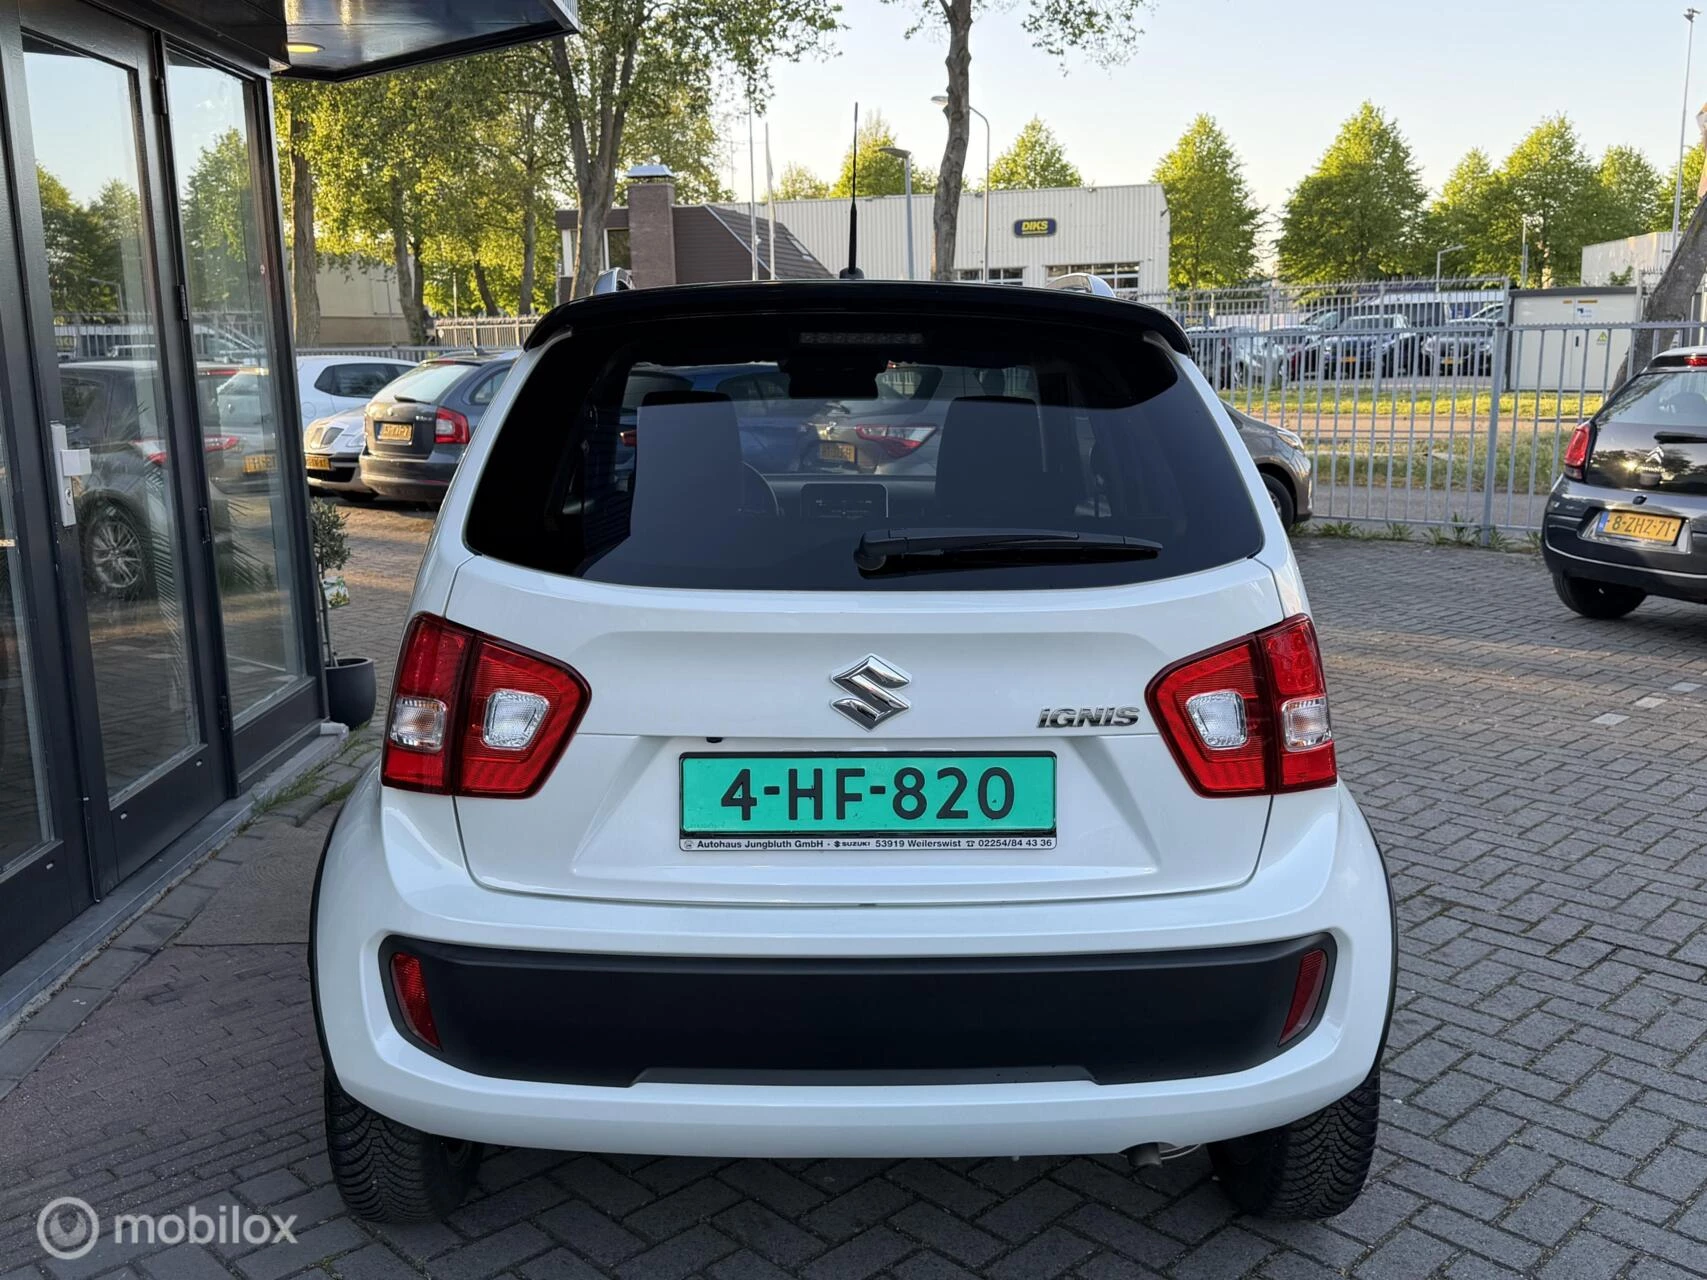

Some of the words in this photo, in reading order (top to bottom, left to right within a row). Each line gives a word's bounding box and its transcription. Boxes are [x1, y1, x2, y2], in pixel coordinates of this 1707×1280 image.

[1022, 220, 1048, 231] DIKS
[1612, 515, 1672, 537] 8-ZHZ-71
[1036, 706, 1140, 728] IGNIS
[720, 766, 1015, 821] 4-HF-820
[697, 839, 742, 849] Autohaus
[745, 839, 792, 850] Jungbluth
[795, 839, 824, 849] GmbH
[875, 839, 905, 848] 53919
[907, 838, 961, 848] Weilerswist
[978, 838, 1023, 848] 02254/84
[1025, 838, 1038, 848] 43
[1040, 838, 1052, 848] 36
